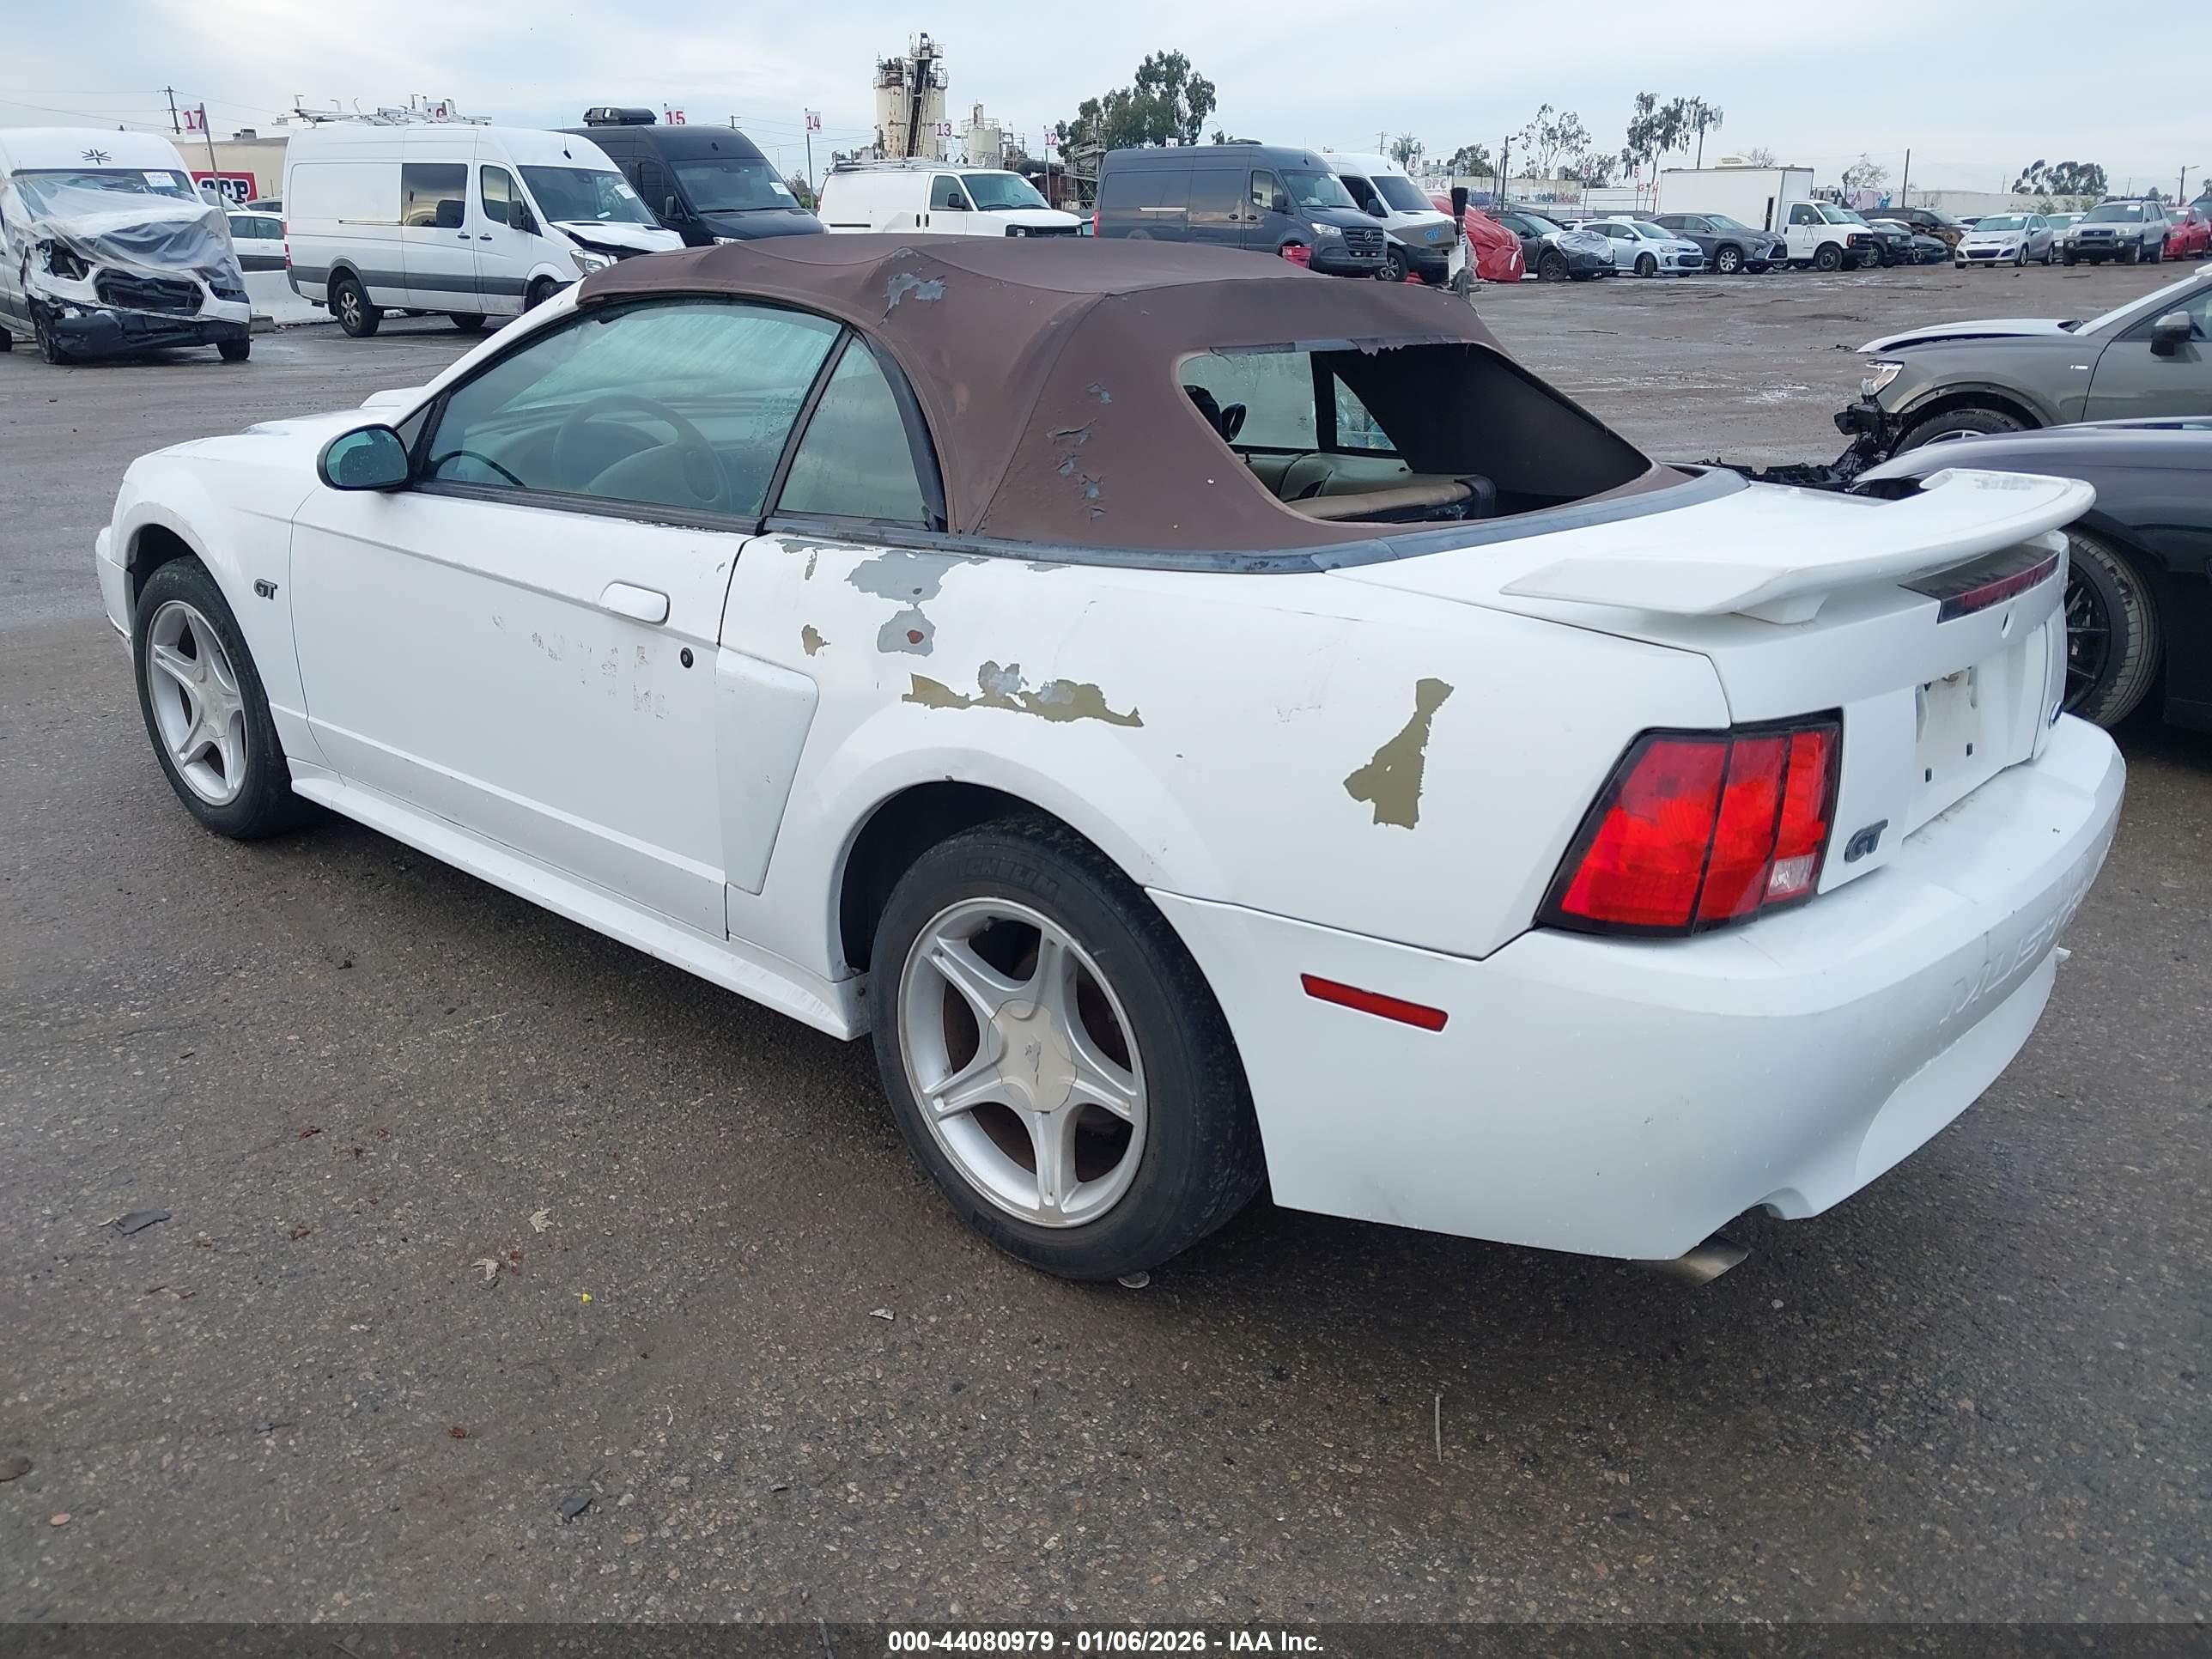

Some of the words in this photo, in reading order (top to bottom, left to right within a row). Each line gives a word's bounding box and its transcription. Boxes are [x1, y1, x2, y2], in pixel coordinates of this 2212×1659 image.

[183, 110, 204, 130] 17
[665, 111, 685, 125] 15
[806, 115, 821, 130] 14
[936, 123, 951, 137] 13
[1045, 133, 1057, 146] 12
[1411, 156, 1416, 169] 8
[1634, 167, 1639, 179] 5
[254, 579, 277, 600] GT
[1844, 819, 1889, 863] GT
